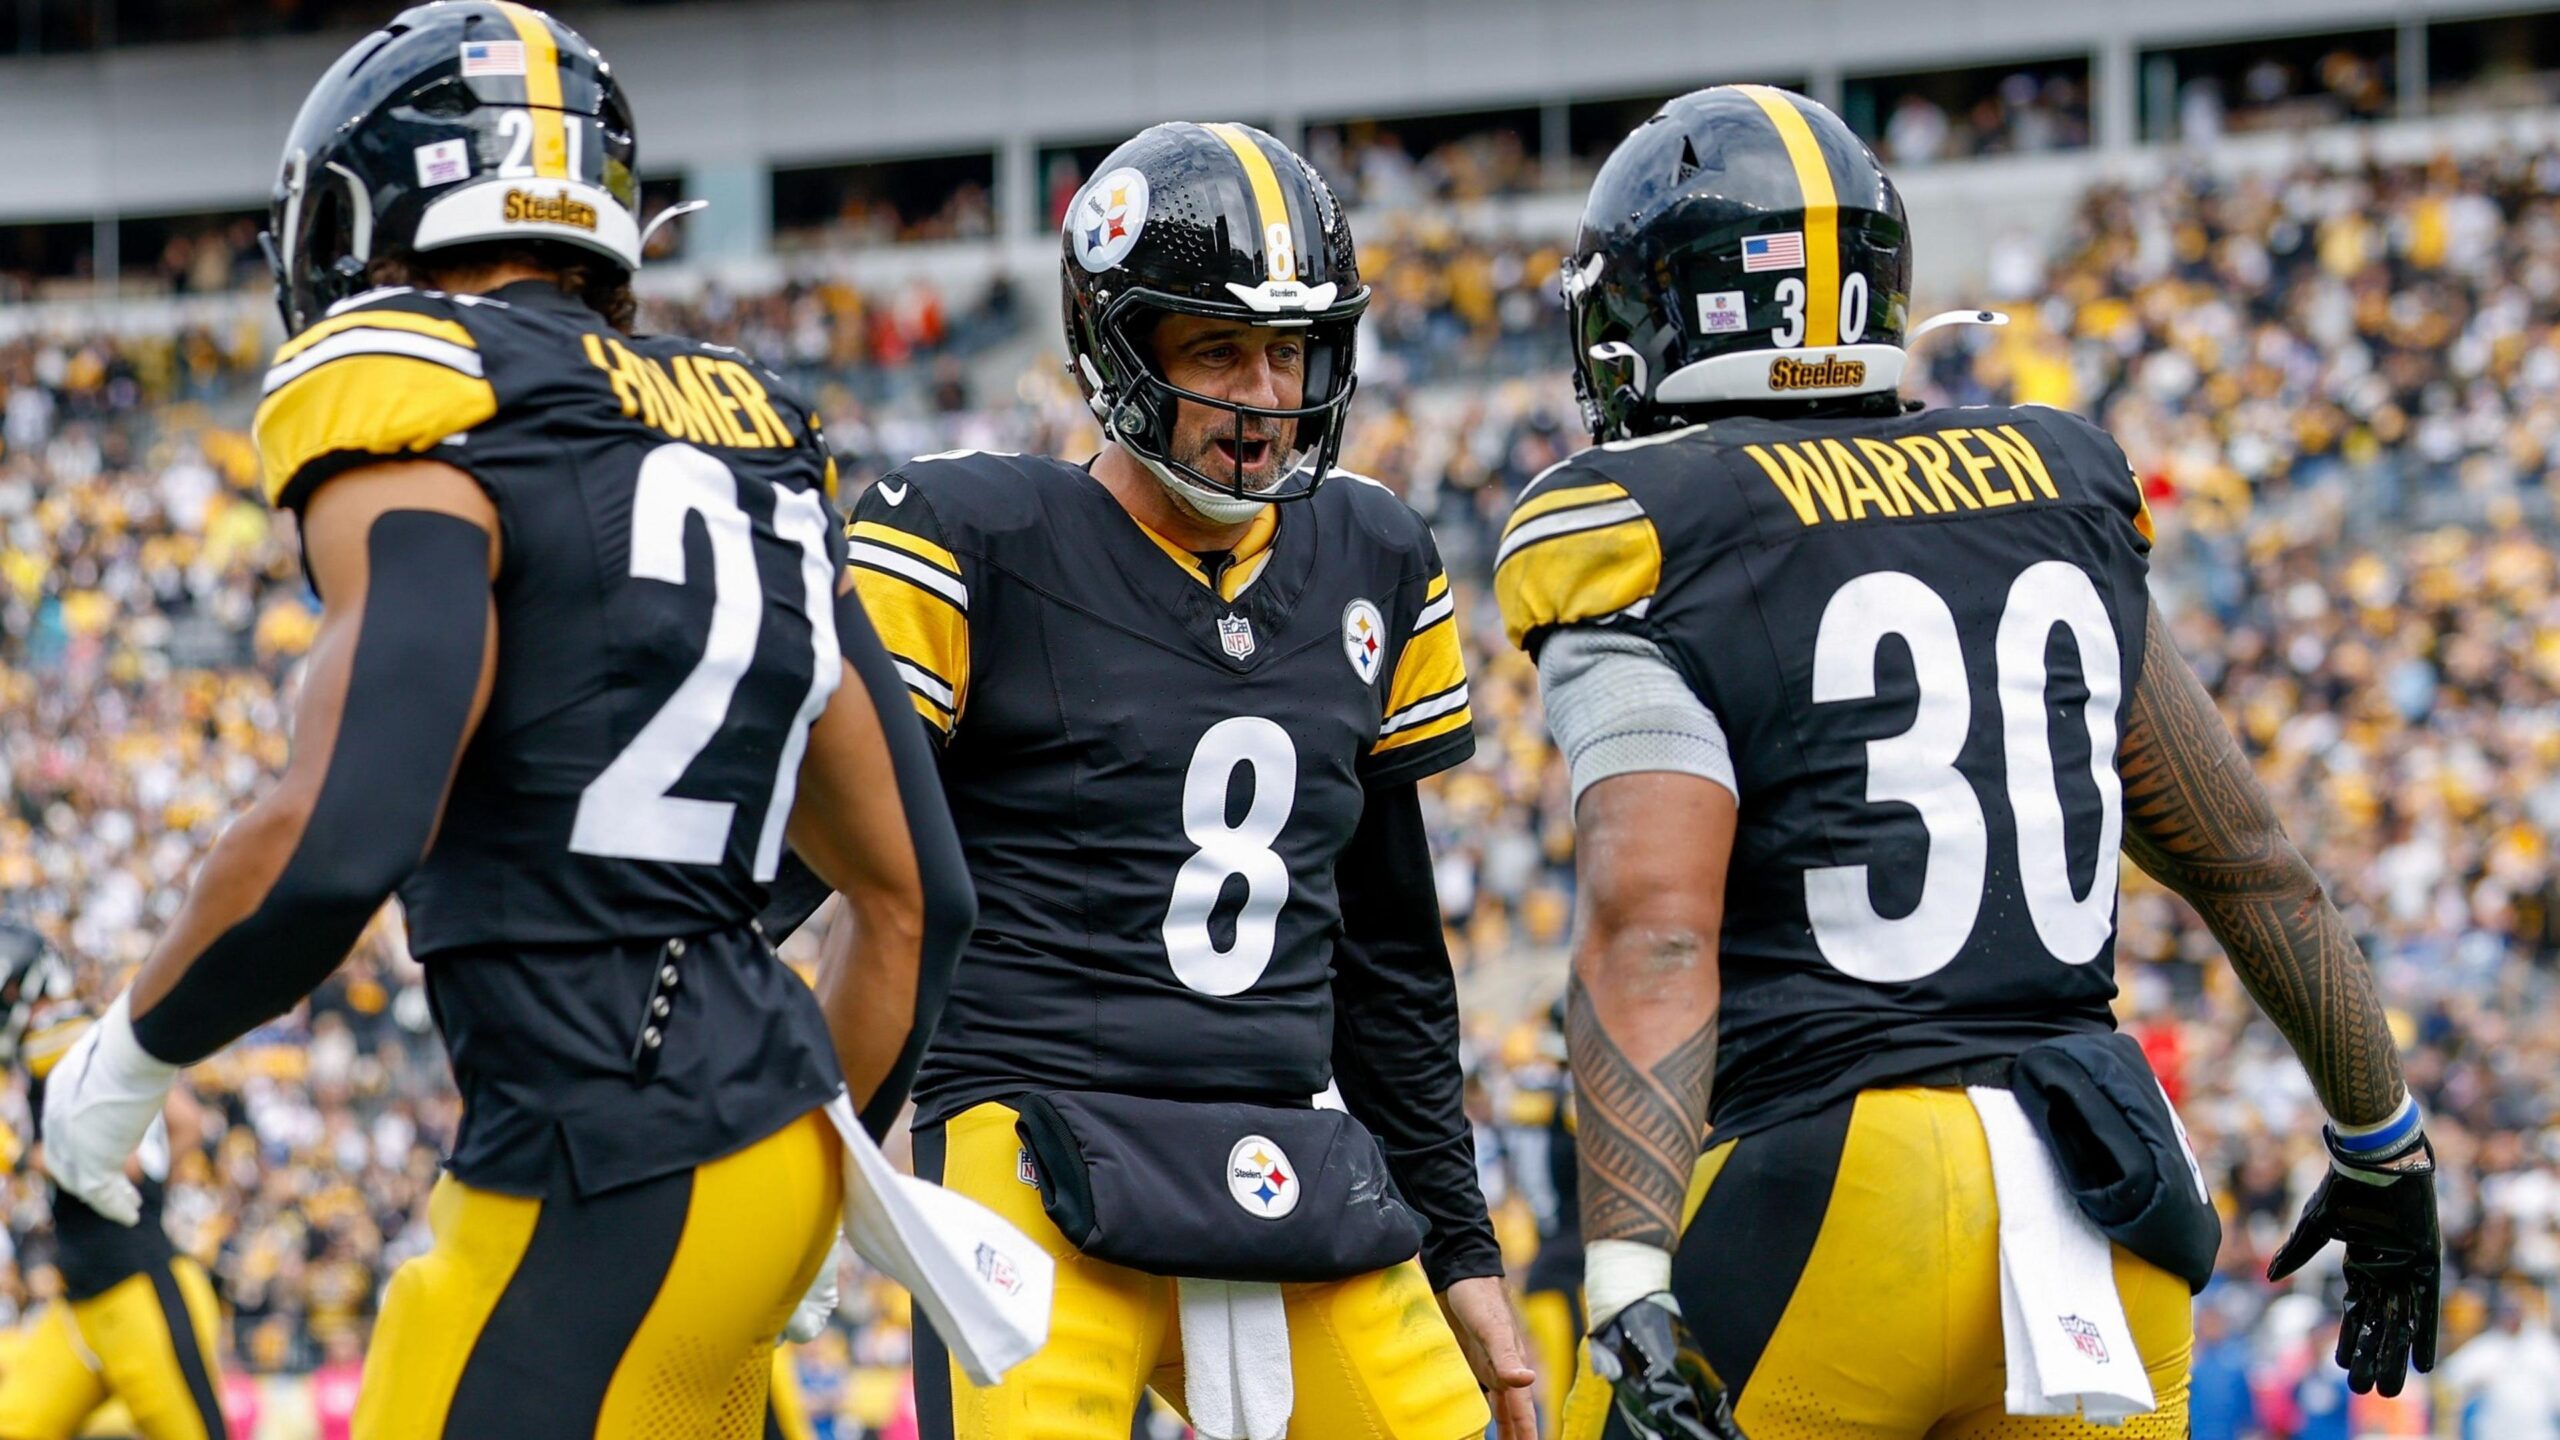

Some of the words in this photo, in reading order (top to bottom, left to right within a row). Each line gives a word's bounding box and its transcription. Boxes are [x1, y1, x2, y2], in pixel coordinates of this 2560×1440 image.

[503, 187, 598, 233] Steelers
[1266, 222, 1295, 281] 8
[1269, 288, 1298, 298] Steelers
[1768, 354, 1866, 392] Steelers
[1744, 425, 2060, 526] WARREN
[568, 442, 842, 883] 21
[1226, 634, 1251, 652] NFL
[1803, 560, 2123, 983] 30
[1162, 716, 1298, 996] 8
[1234, 1167, 1262, 1179] Steelers
